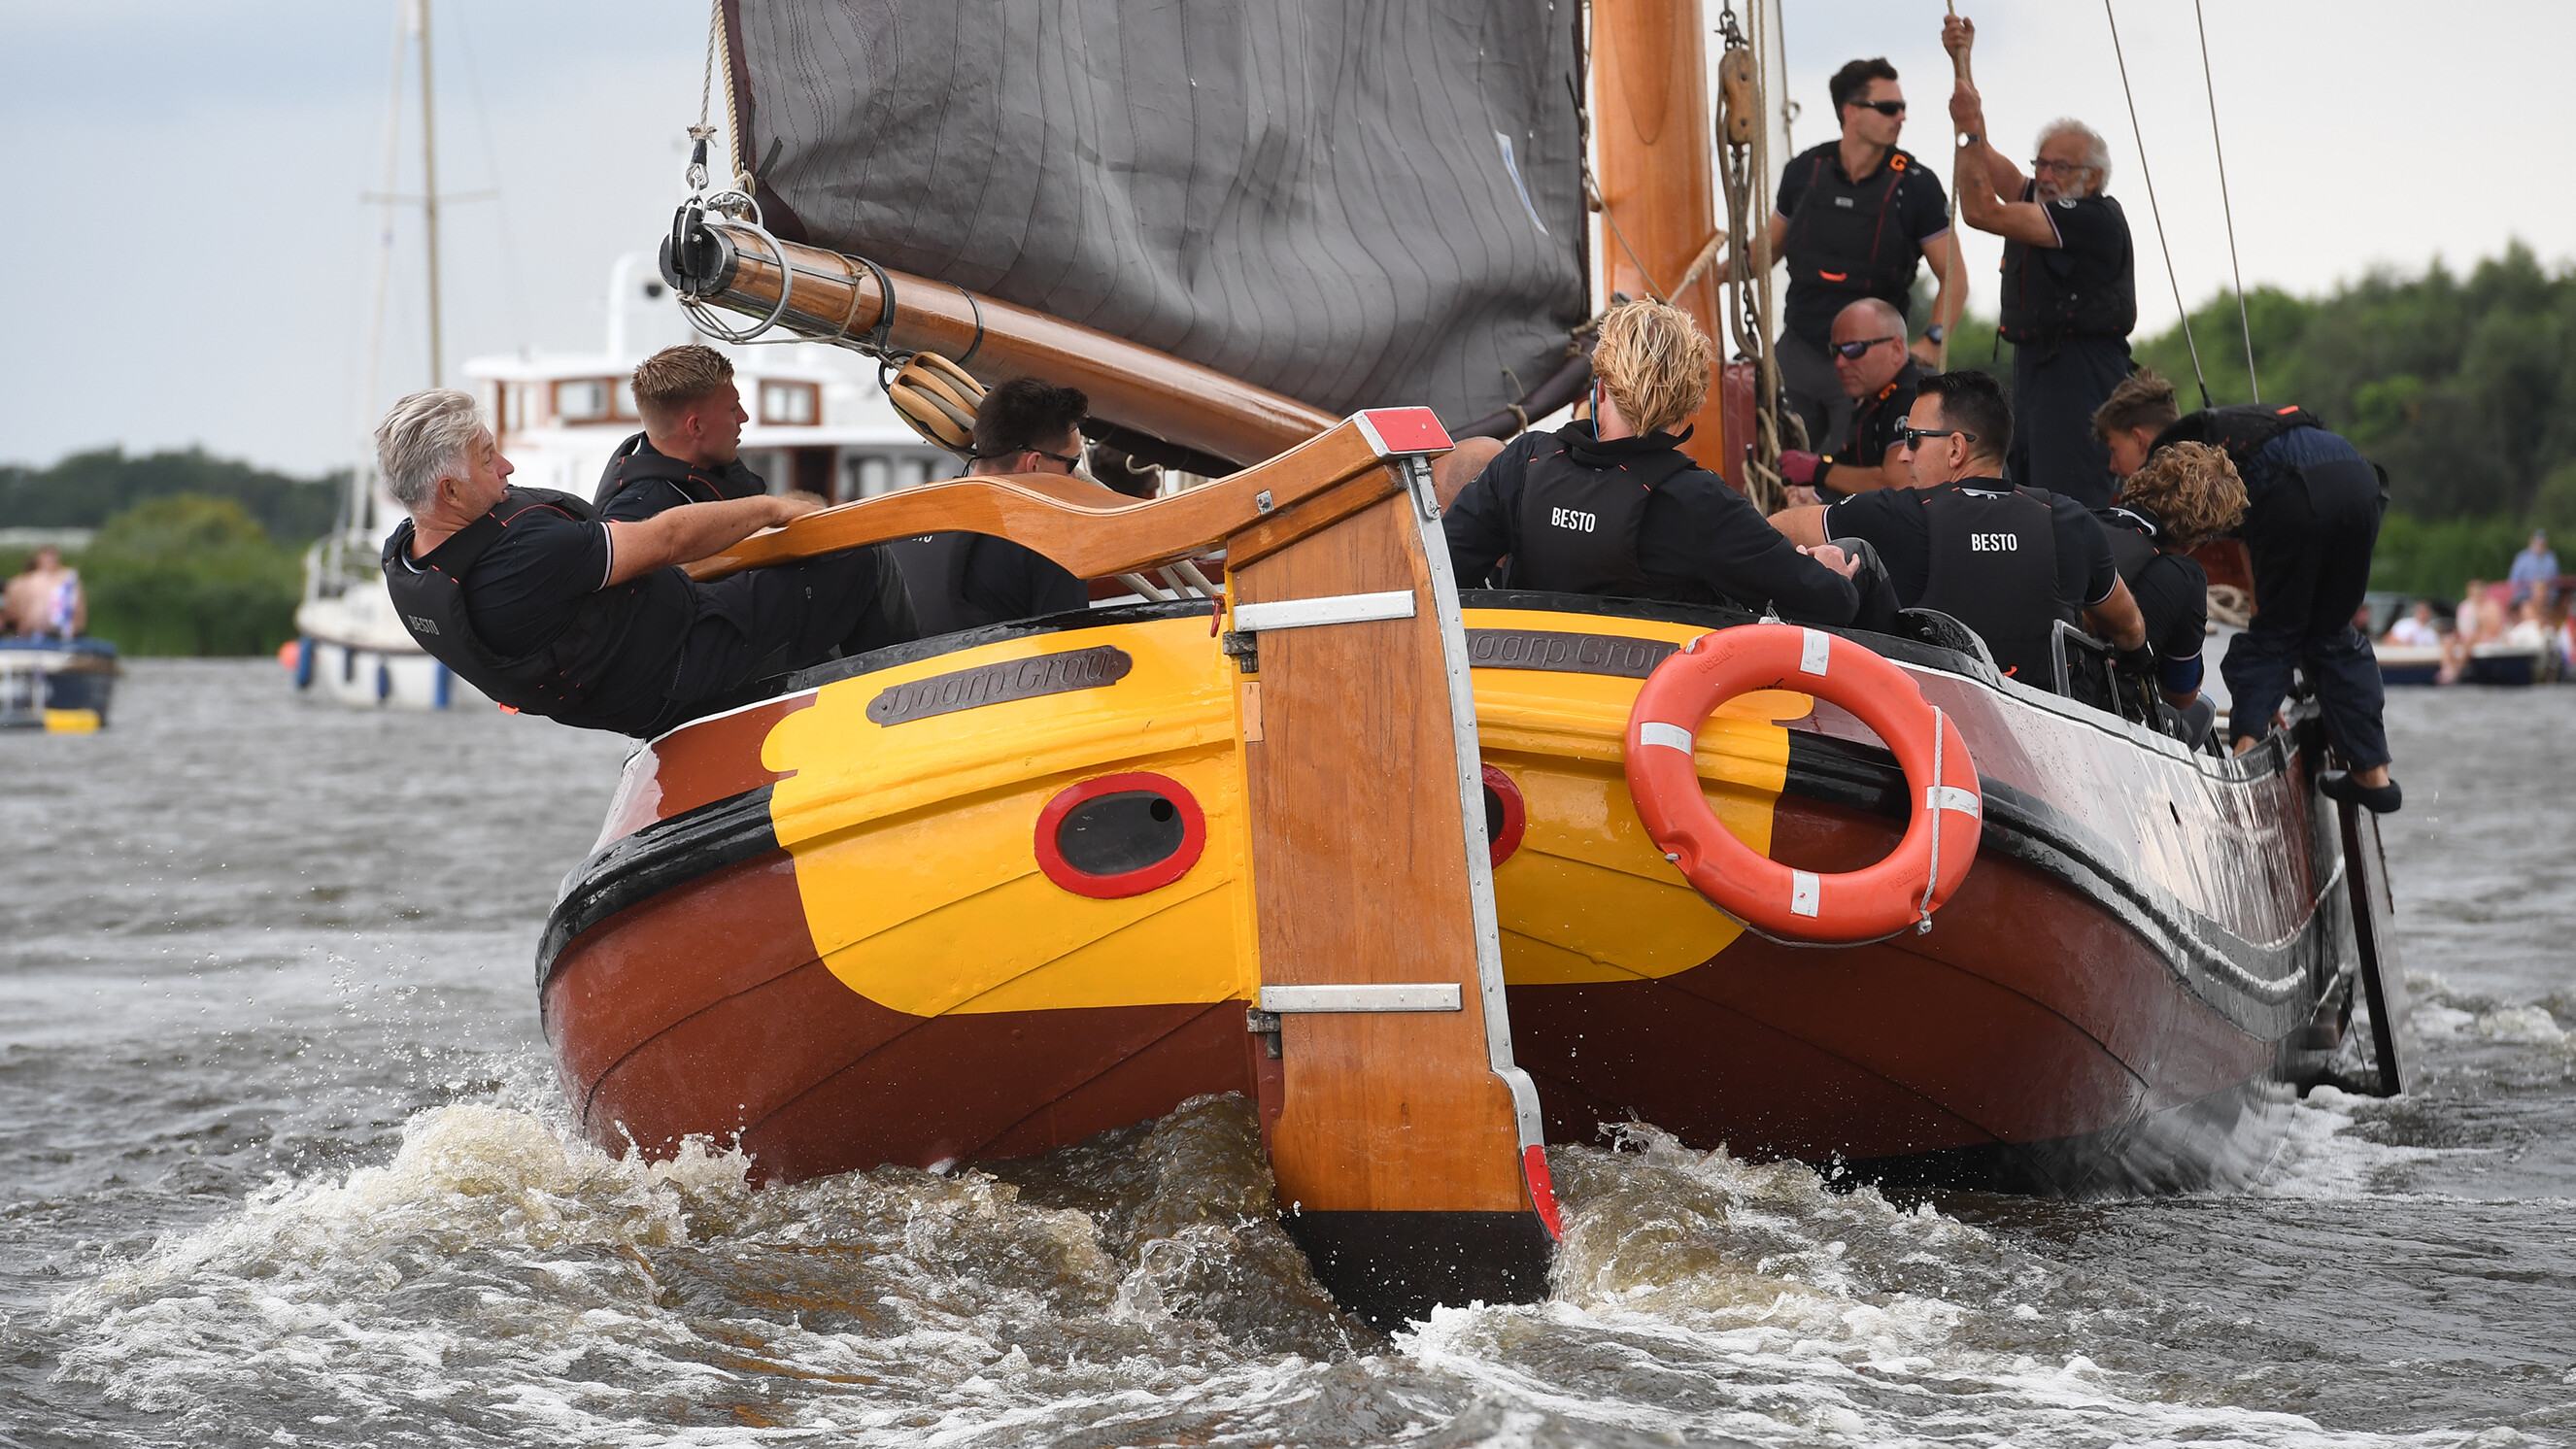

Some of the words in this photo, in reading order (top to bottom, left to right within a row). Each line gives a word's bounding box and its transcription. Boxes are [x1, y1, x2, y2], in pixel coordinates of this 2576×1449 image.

[1551, 506, 1596, 533] BESTO
[1971, 533, 2017, 552] BESTO
[407, 614, 440, 636] BESTO
[1465, 632, 1569, 667] oarp
[888, 670, 1006, 718] Doarp
[1016, 653, 1109, 691] Grou
